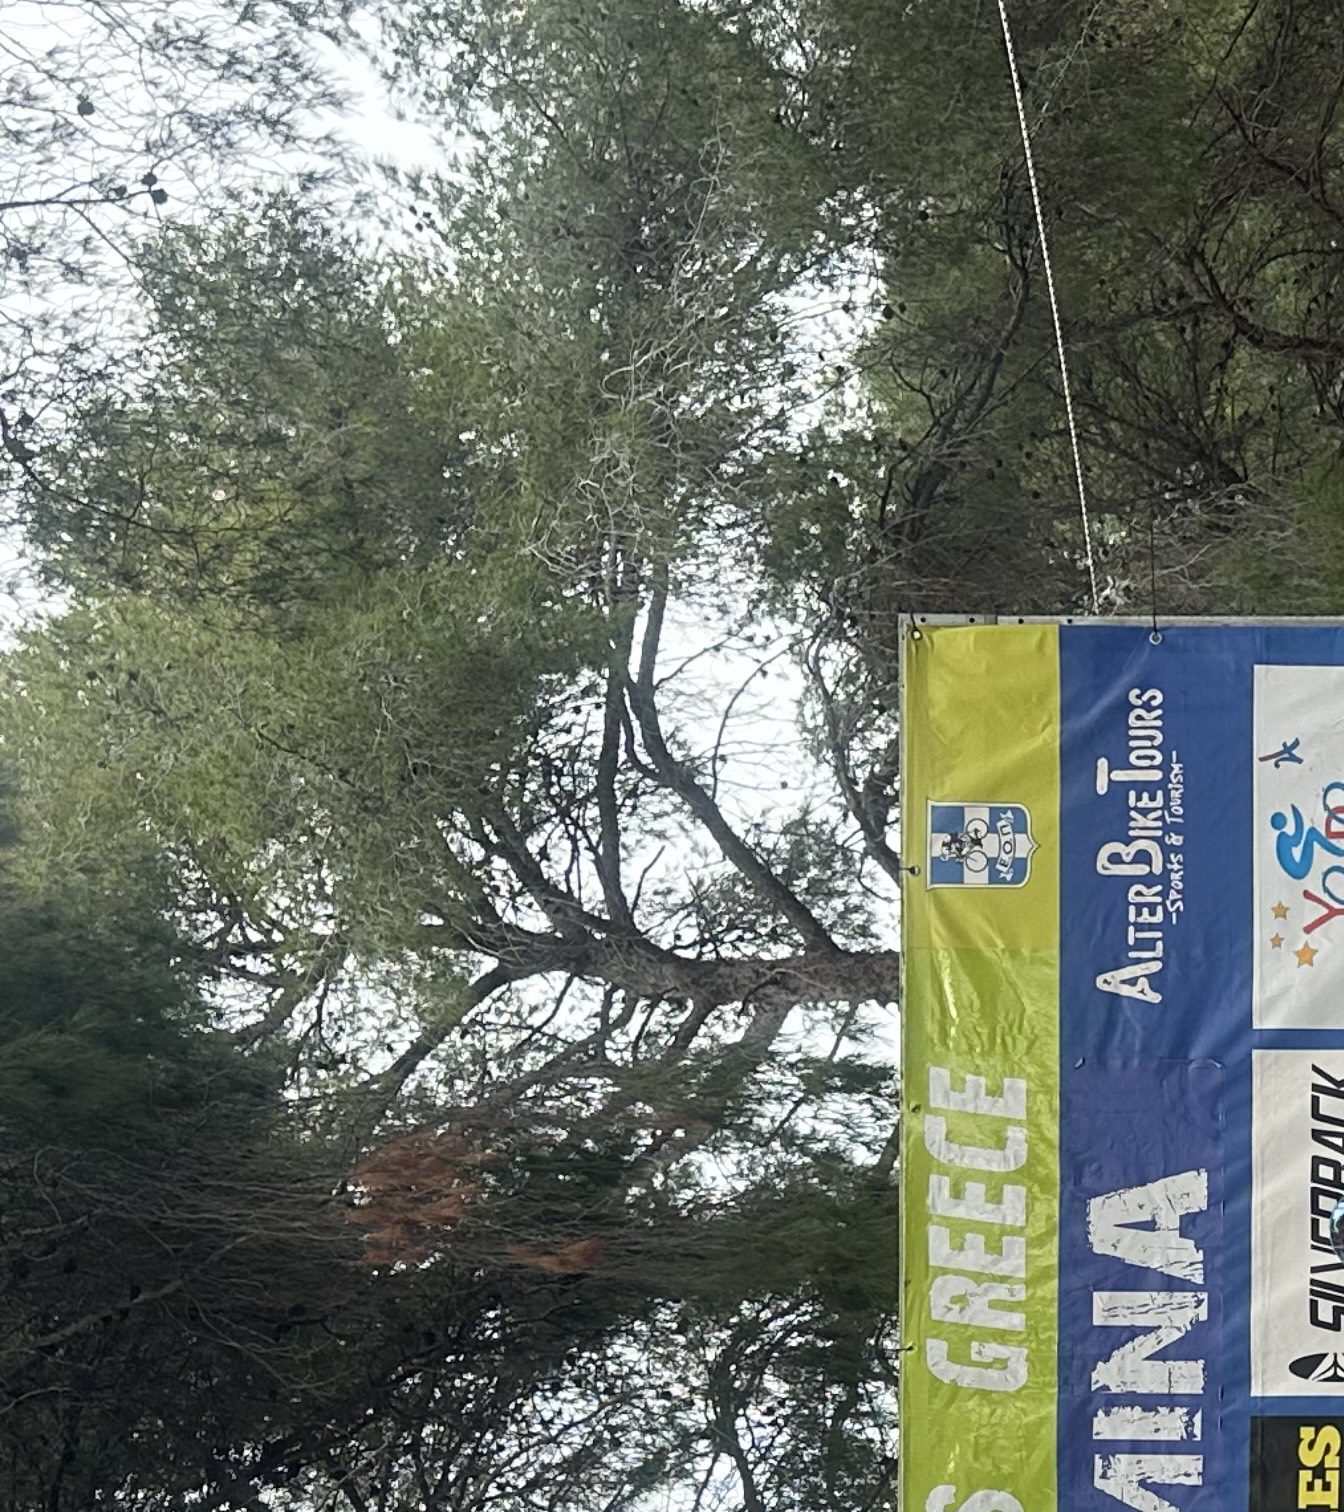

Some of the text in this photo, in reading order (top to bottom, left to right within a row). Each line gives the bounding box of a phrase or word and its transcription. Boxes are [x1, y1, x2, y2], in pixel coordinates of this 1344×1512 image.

[1095, 687, 1164, 1004] ALTER BIKE TOURS
[1165, 834, 1184, 845] &
[924, 1067, 1029, 1392] GREECE
